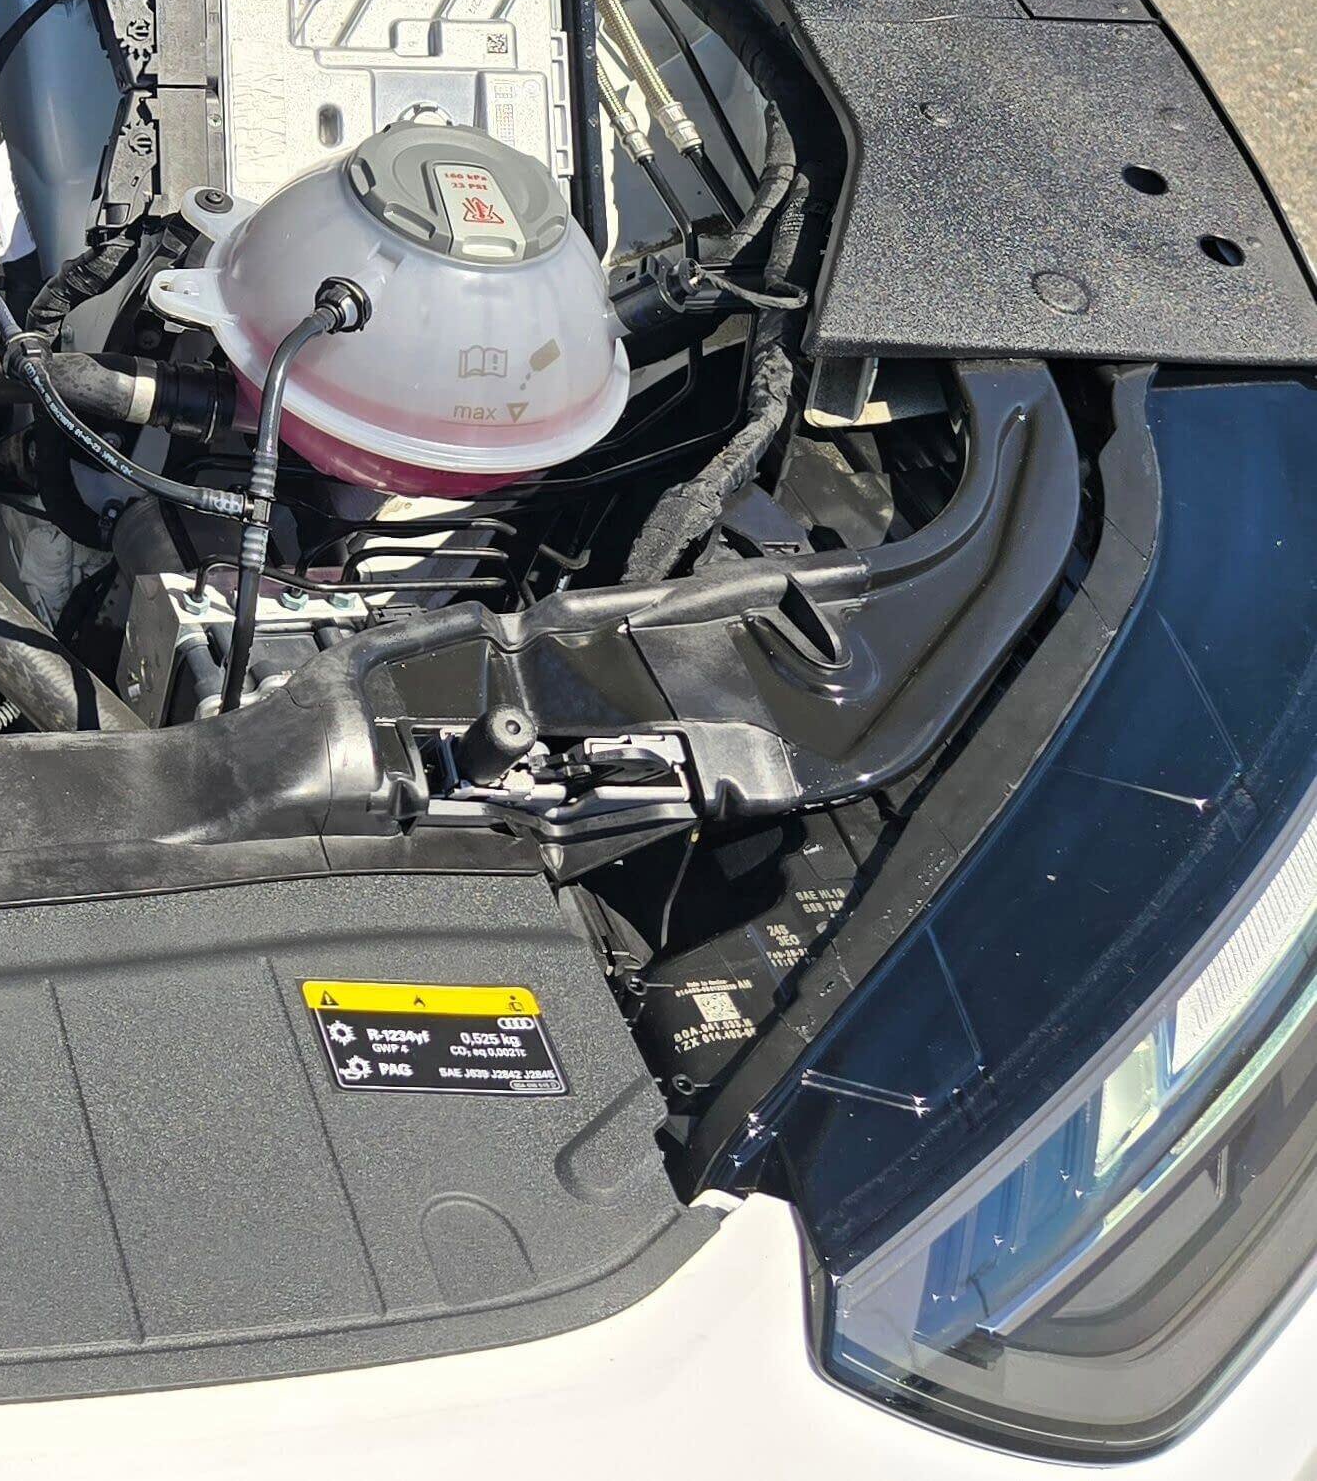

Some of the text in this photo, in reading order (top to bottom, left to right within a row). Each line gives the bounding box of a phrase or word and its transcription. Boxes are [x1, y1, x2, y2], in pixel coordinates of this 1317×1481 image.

[468, 183, 489, 191] PSI
[453, 405, 498, 421] max
[795, 891, 819, 902] SAE
[366, 1028, 522, 1047] R-1234yf 0,525 kg
[371, 1043, 399, 1053] GWP
[400, 1044, 410, 1053] 4
[473, 1049, 487, 1059] eq
[378, 1062, 413, 1077] PAG
[439, 1067, 463, 1077] SAE
